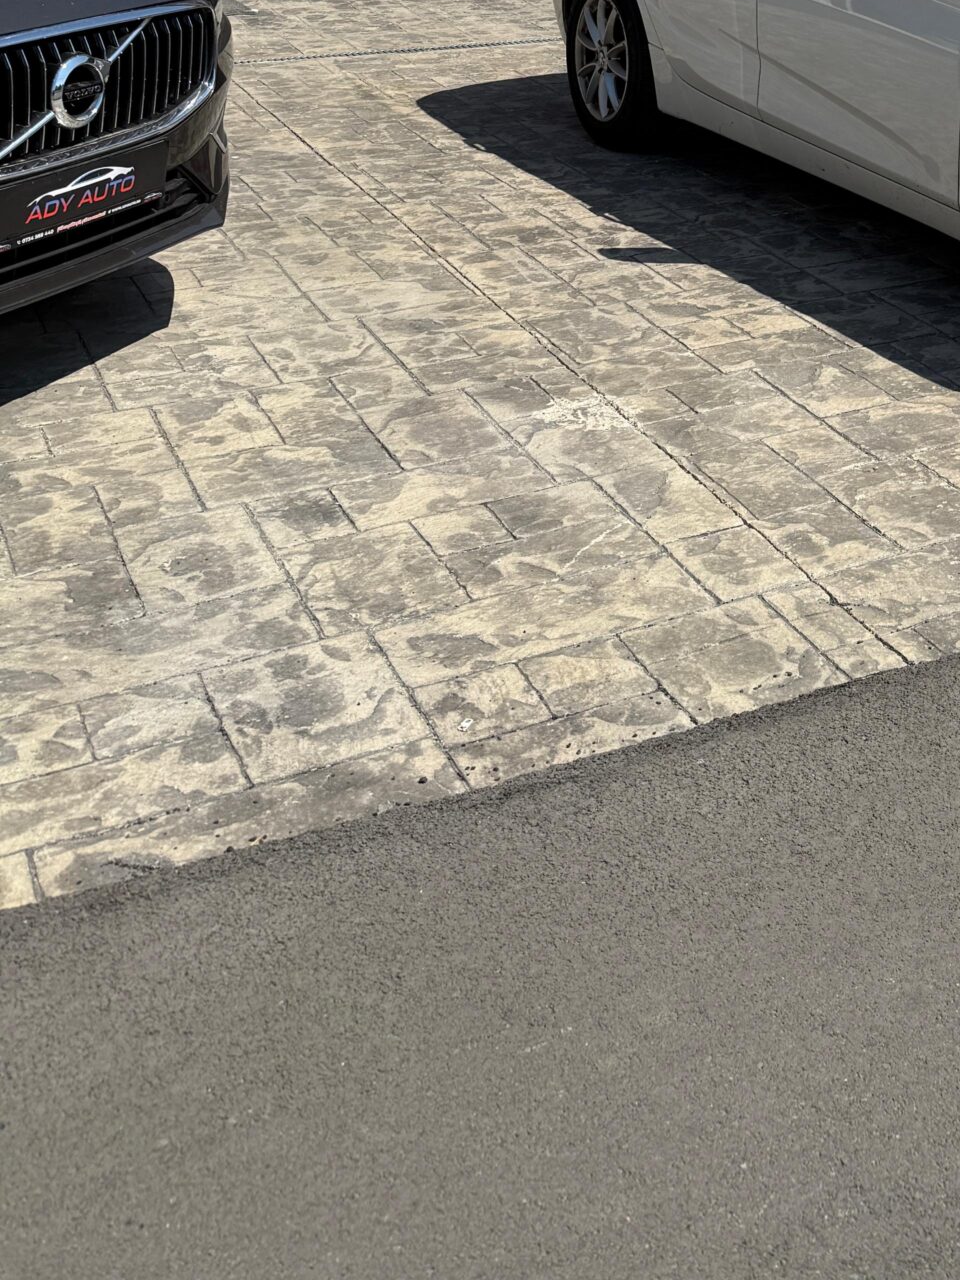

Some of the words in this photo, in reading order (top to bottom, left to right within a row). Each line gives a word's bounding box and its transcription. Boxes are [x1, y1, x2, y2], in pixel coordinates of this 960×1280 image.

[64, 84, 102, 100] VOLVO
[24, 193, 75, 225] ADY
[77, 175, 136, 208] AUTO
